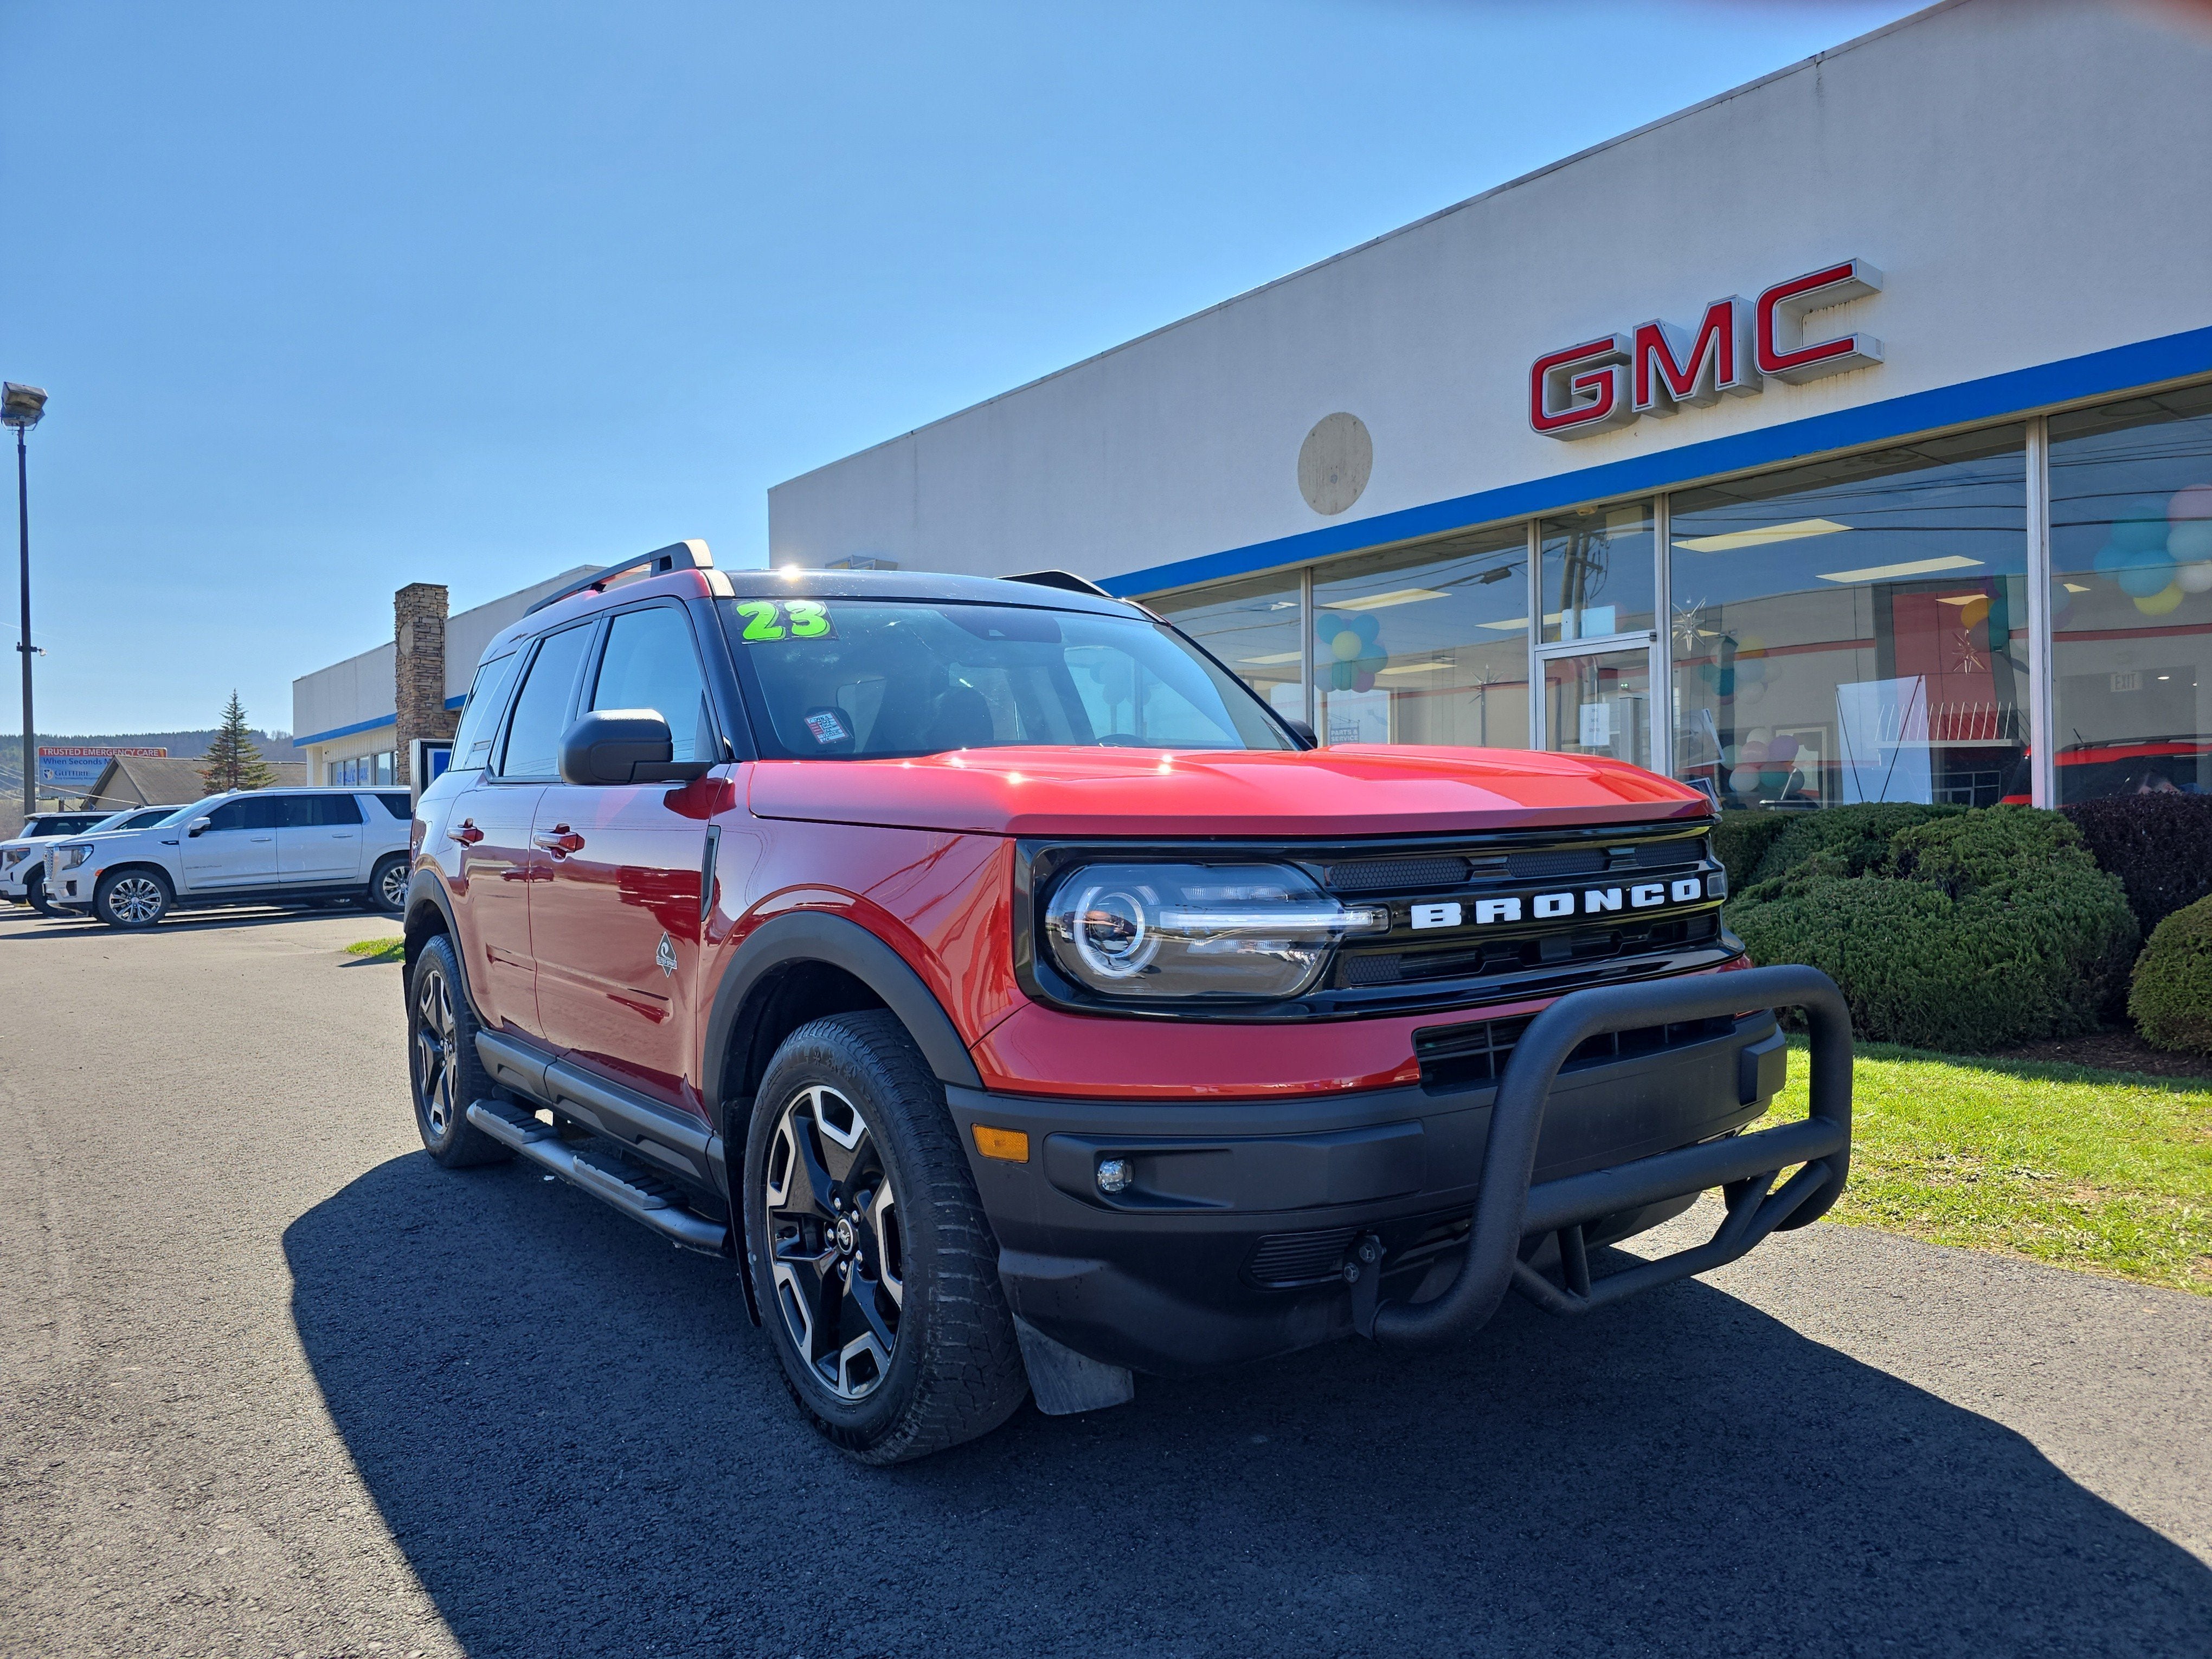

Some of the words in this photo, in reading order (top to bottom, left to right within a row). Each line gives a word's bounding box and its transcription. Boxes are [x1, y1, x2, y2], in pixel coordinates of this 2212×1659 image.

[1529, 258, 1885, 441] GMC
[736, 600, 831, 641] 23
[2115, 673, 2136, 690] EXIT
[1411, 878, 1701, 930] BRONCO
